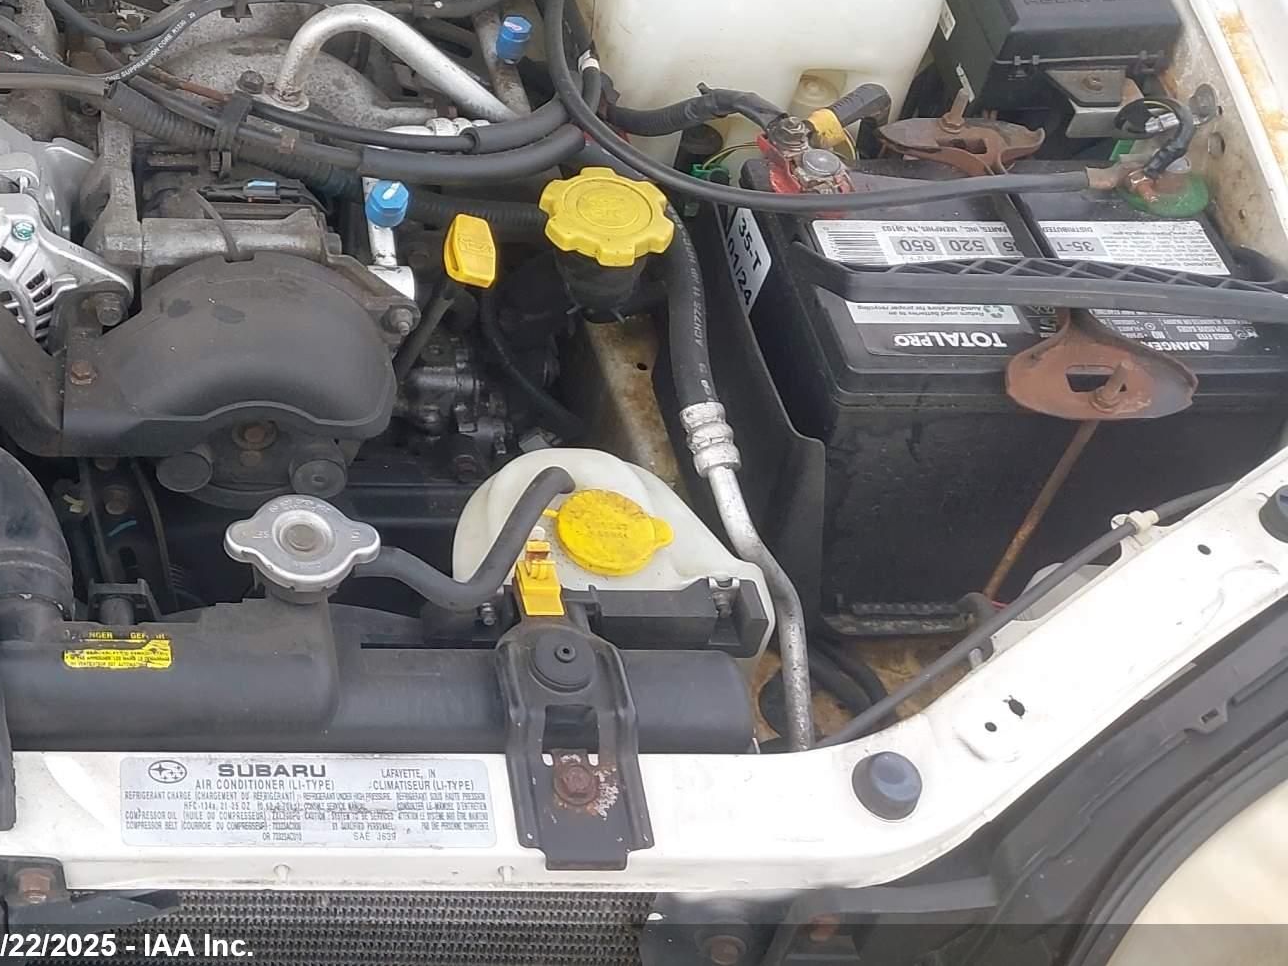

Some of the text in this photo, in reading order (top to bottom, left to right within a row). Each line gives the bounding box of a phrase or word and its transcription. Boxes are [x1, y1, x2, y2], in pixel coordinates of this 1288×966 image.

[120, 47, 161, 78] SUPPRESSION
[735, 216, 763, 271] 35-T
[900, 238, 936, 252] 650
[949, 239, 985, 252] 520
[1057, 241, 1095, 253] 35-T
[218, 764, 326, 778] SUBARU
[381, 768, 436, 780] LAFAYETTE, IN
[195, 779, 335, 791] AIR CONDITIONER (LI-TYPE)
[373, 780, 474, 792] CLIMATISEUR (LI-TYPE)
[353, 832, 371, 841] SAE
